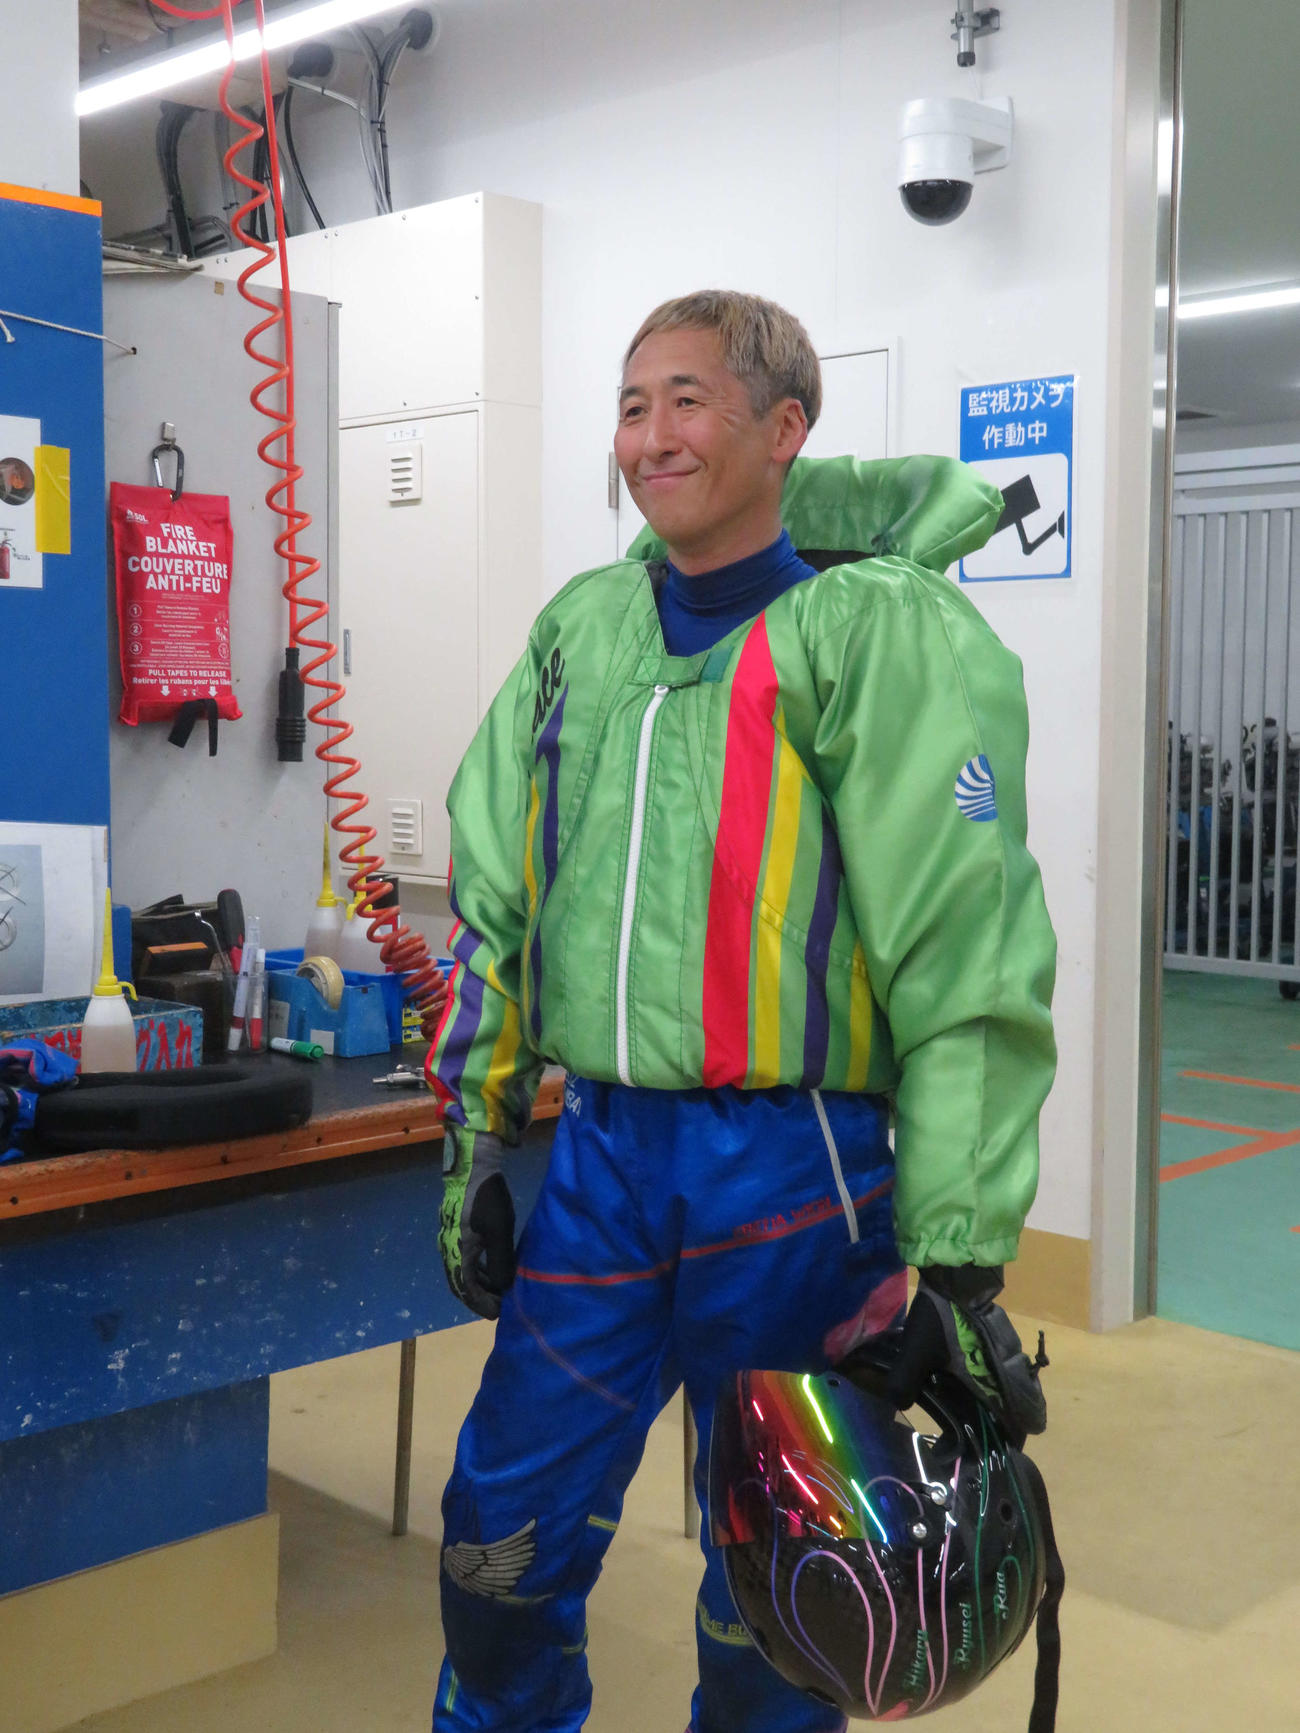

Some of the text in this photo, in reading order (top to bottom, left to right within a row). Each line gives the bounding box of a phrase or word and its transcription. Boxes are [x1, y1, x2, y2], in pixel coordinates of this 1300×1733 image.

[967, 384, 1064, 417] 監視カメラ
[982, 420, 1047, 450] 作動中
[160, 523, 197, 540] FIRE
[146, 536, 216, 557] BLANKET
[128, 556, 228, 579] COUVERTURE
[146, 574, 220, 593] ANTI-FEU
[158, 677, 169, 685] les
[170, 677, 193, 685] rubans
[193, 678, 208, 686] pour
[167, 669, 188, 677] TAPES
[956, 1602, 973, 1668] Ryusei
[906, 1629, 928, 1690] Hikaru
